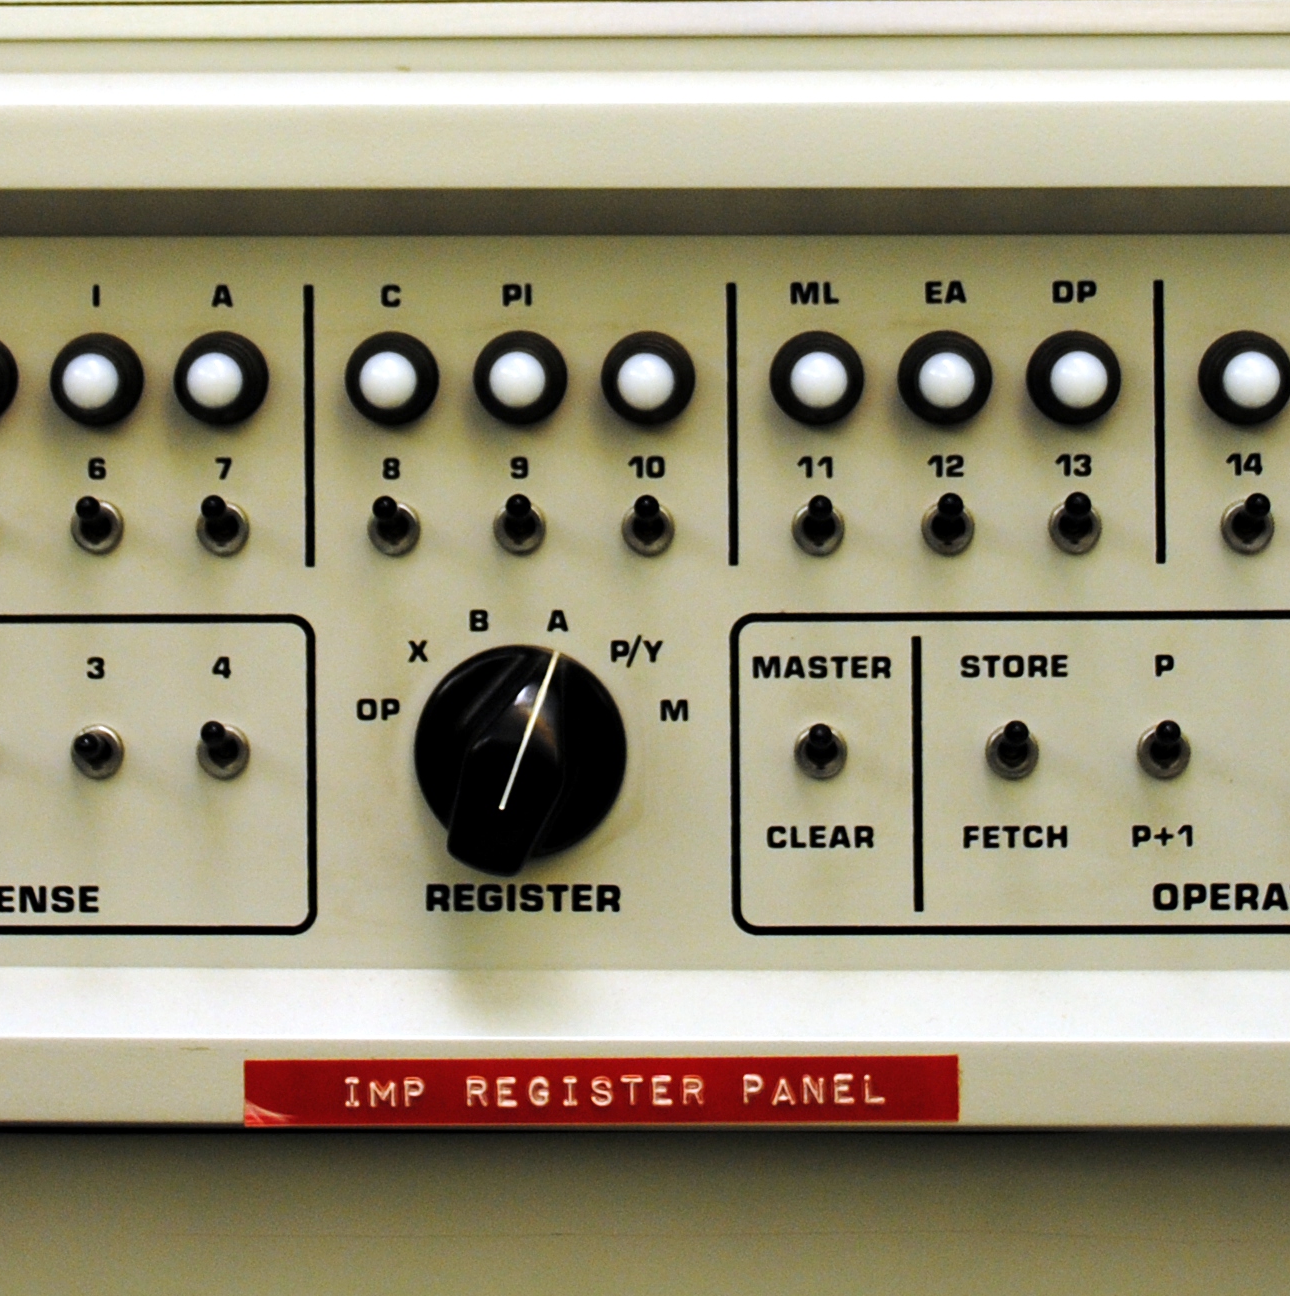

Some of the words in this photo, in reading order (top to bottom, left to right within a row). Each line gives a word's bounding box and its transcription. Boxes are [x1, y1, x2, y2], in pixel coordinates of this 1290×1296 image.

[92, 284, 100, 307] I
[212, 284, 233, 307] A
[381, 284, 401, 307] C
[502, 283, 532, 307] PI
[790, 281, 839, 305] ML
[925, 280, 966, 304] EA
[1052, 280, 1097, 303] DP
[88, 457, 106, 480] 6
[215, 457, 232, 480] 7
[383, 457, 400, 480] 8
[510, 456, 529, 479] 9
[628, 455, 665, 478] 10
[797, 456, 833, 478] 11
[927, 454, 964, 477] 12
[1055, 453, 1092, 477] 13
[1226, 453, 1263, 476] 14
[469, 609, 489, 632] B
[547, 610, 568, 632] A
[409, 640, 428, 663] X
[611, 635, 663, 668] P/Y
[87, 657, 105, 679] 3
[212, 656, 231, 679] 4
[753, 656, 891, 679] MASTER
[961, 655, 1068, 678] STORE
[1155, 654, 1174, 677] P
[357, 698, 400, 721] OP
[660, 699, 688, 721] M
[767, 825, 874, 848] CLEAR
[963, 825, 1068, 848] FETCH
[1132, 825, 1193, 847] P+1
[426, 884, 621, 913] REGISTER
[345, 1076, 425, 1108] IMP
[467, 1075, 705, 1106] REGISTER
[742, 1073, 887, 1105] PANEL
